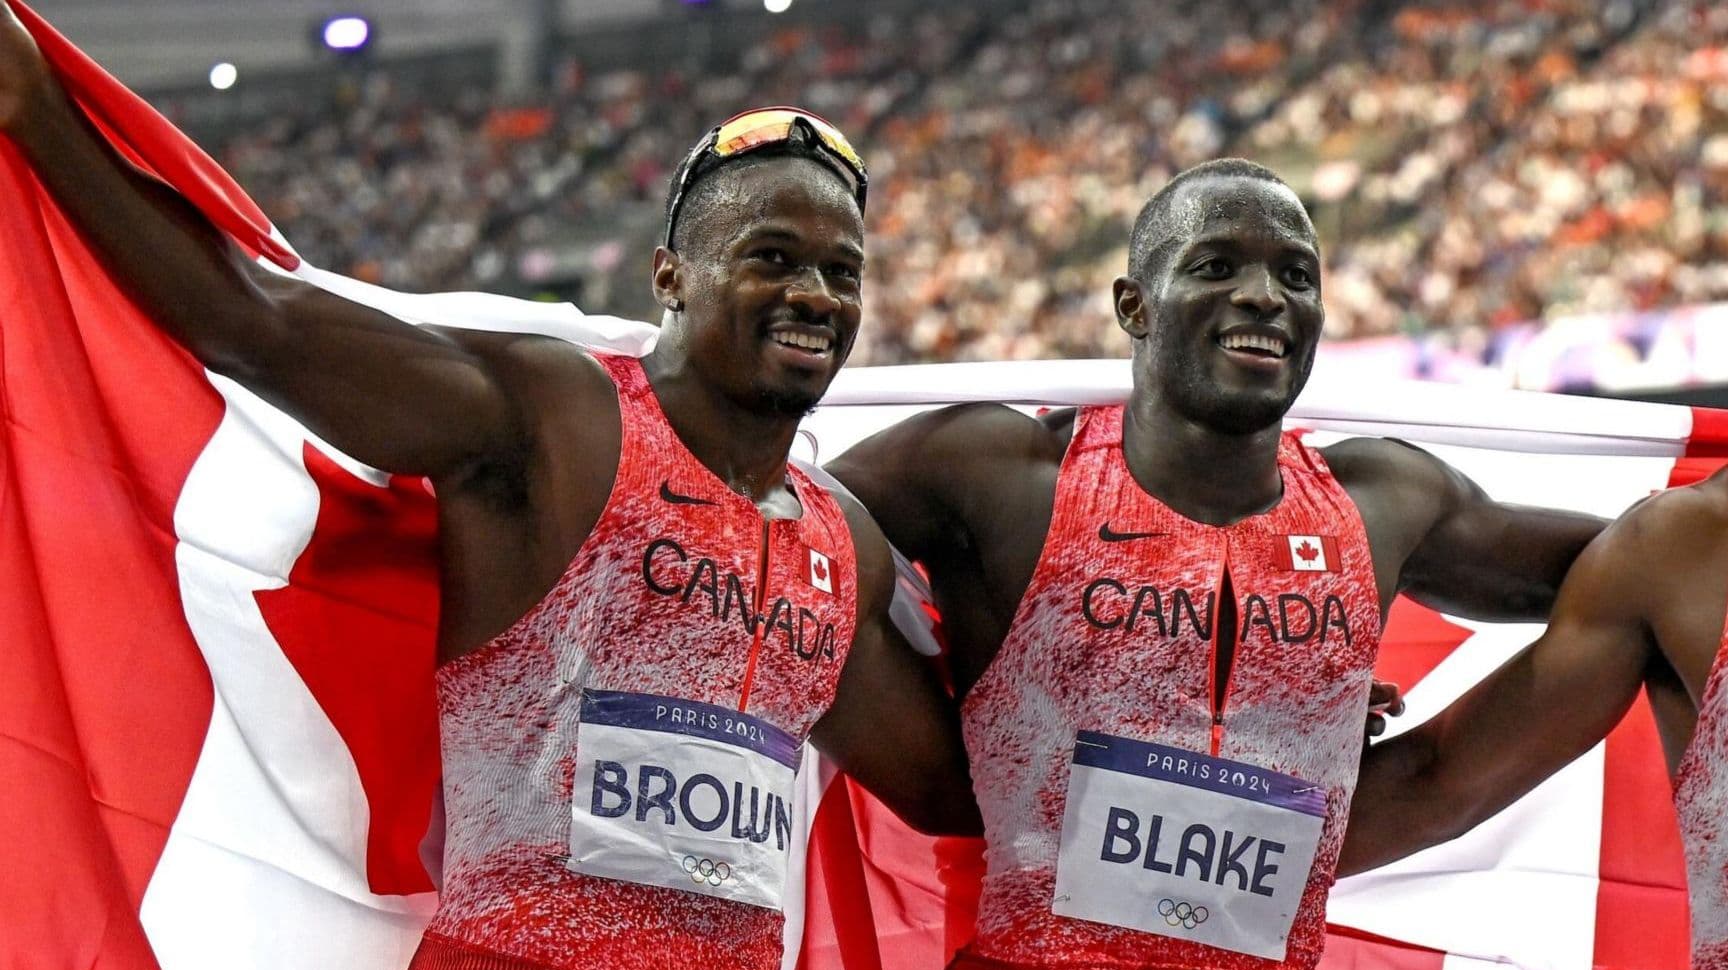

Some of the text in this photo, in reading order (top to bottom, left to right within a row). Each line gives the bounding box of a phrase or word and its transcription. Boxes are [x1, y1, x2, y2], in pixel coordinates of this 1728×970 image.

[642, 538, 834, 669] CANADA
[1082, 578, 1350, 645] CANADA
[725, 718, 766, 745] 2024
[590, 759, 793, 851] BROWN
[1218, 768, 1271, 793] 2024
[1101, 806, 1286, 897] BLAKE
